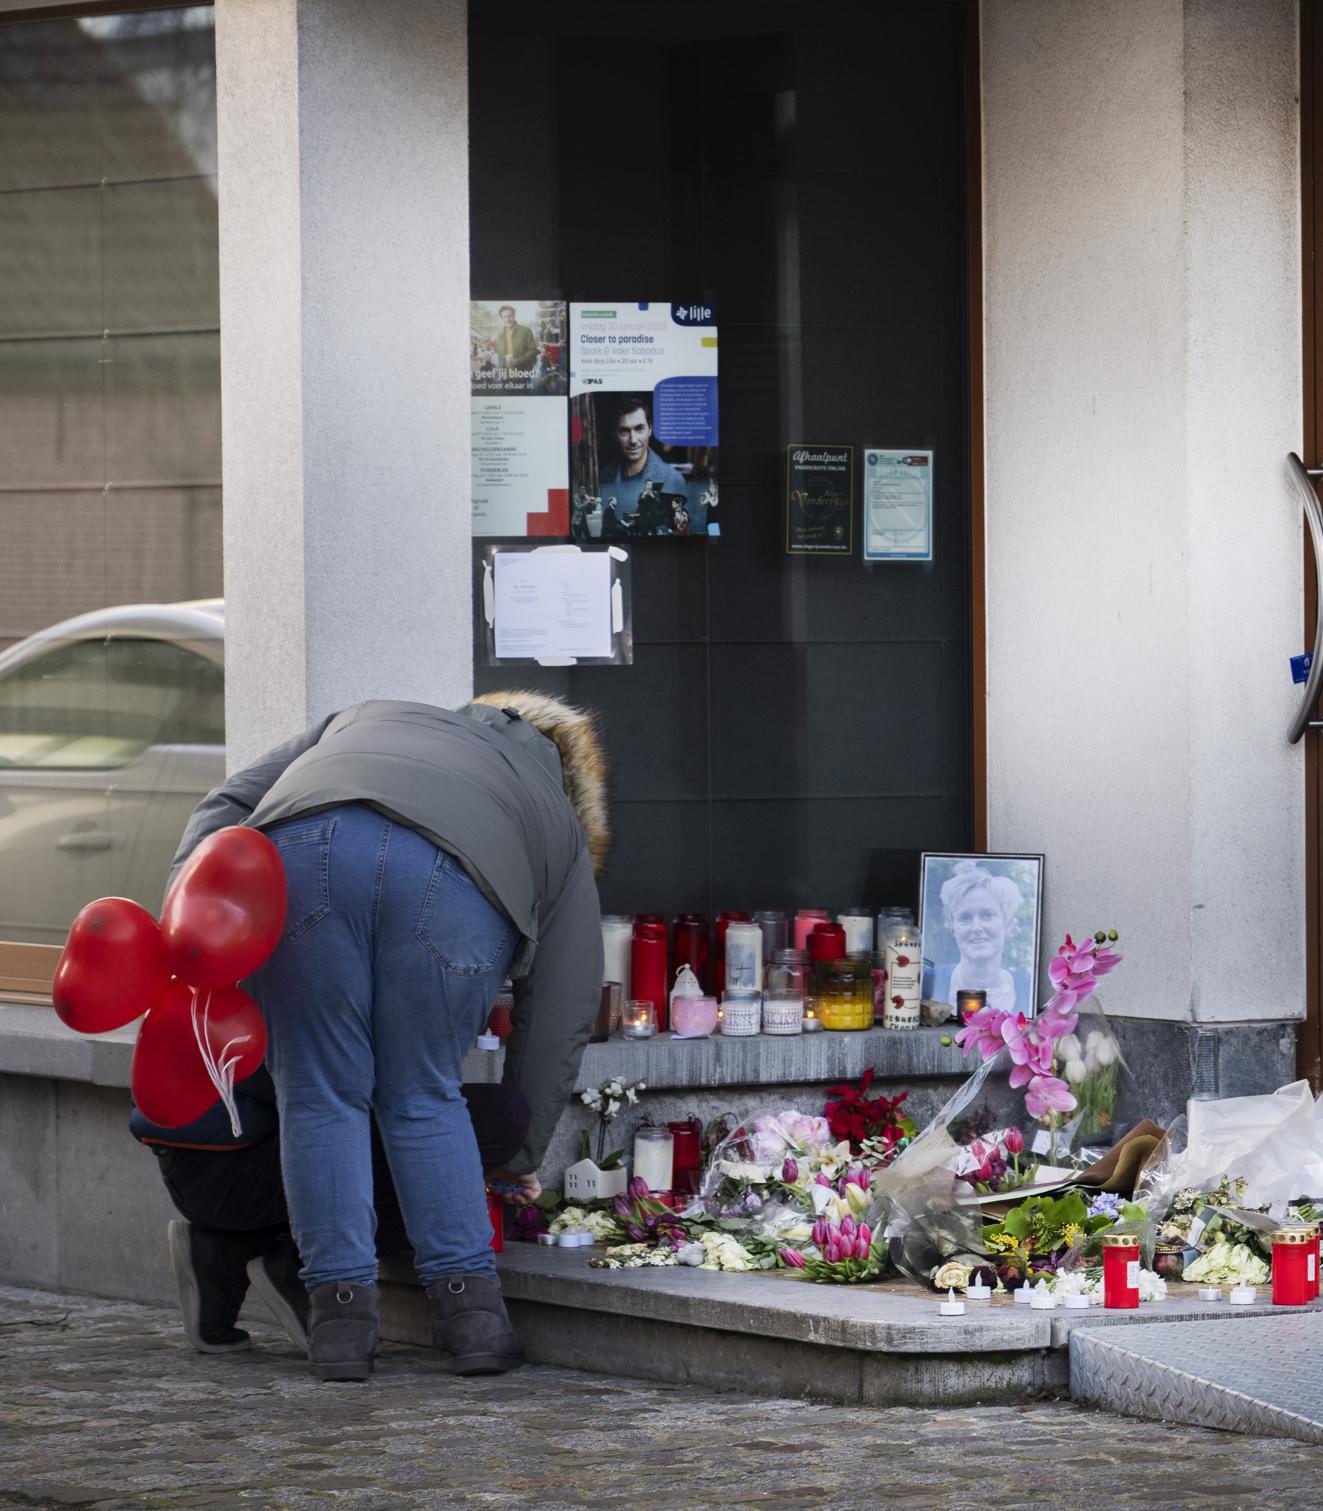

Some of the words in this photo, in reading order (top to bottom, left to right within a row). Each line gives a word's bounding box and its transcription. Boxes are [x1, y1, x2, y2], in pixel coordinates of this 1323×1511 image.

[689, 305, 712, 321] lille
[580, 334, 606, 344] Closer
[608, 334, 616, 344] to
[618, 333, 654, 345] paradise
[475, 368, 496, 380] geef
[497, 367, 507, 380] jij
[508, 367, 539, 378] bloed?
[504, 381, 525, 390] elkaar
[526, 381, 534, 390] in
[792, 450, 848, 464] Afhaalpunt
